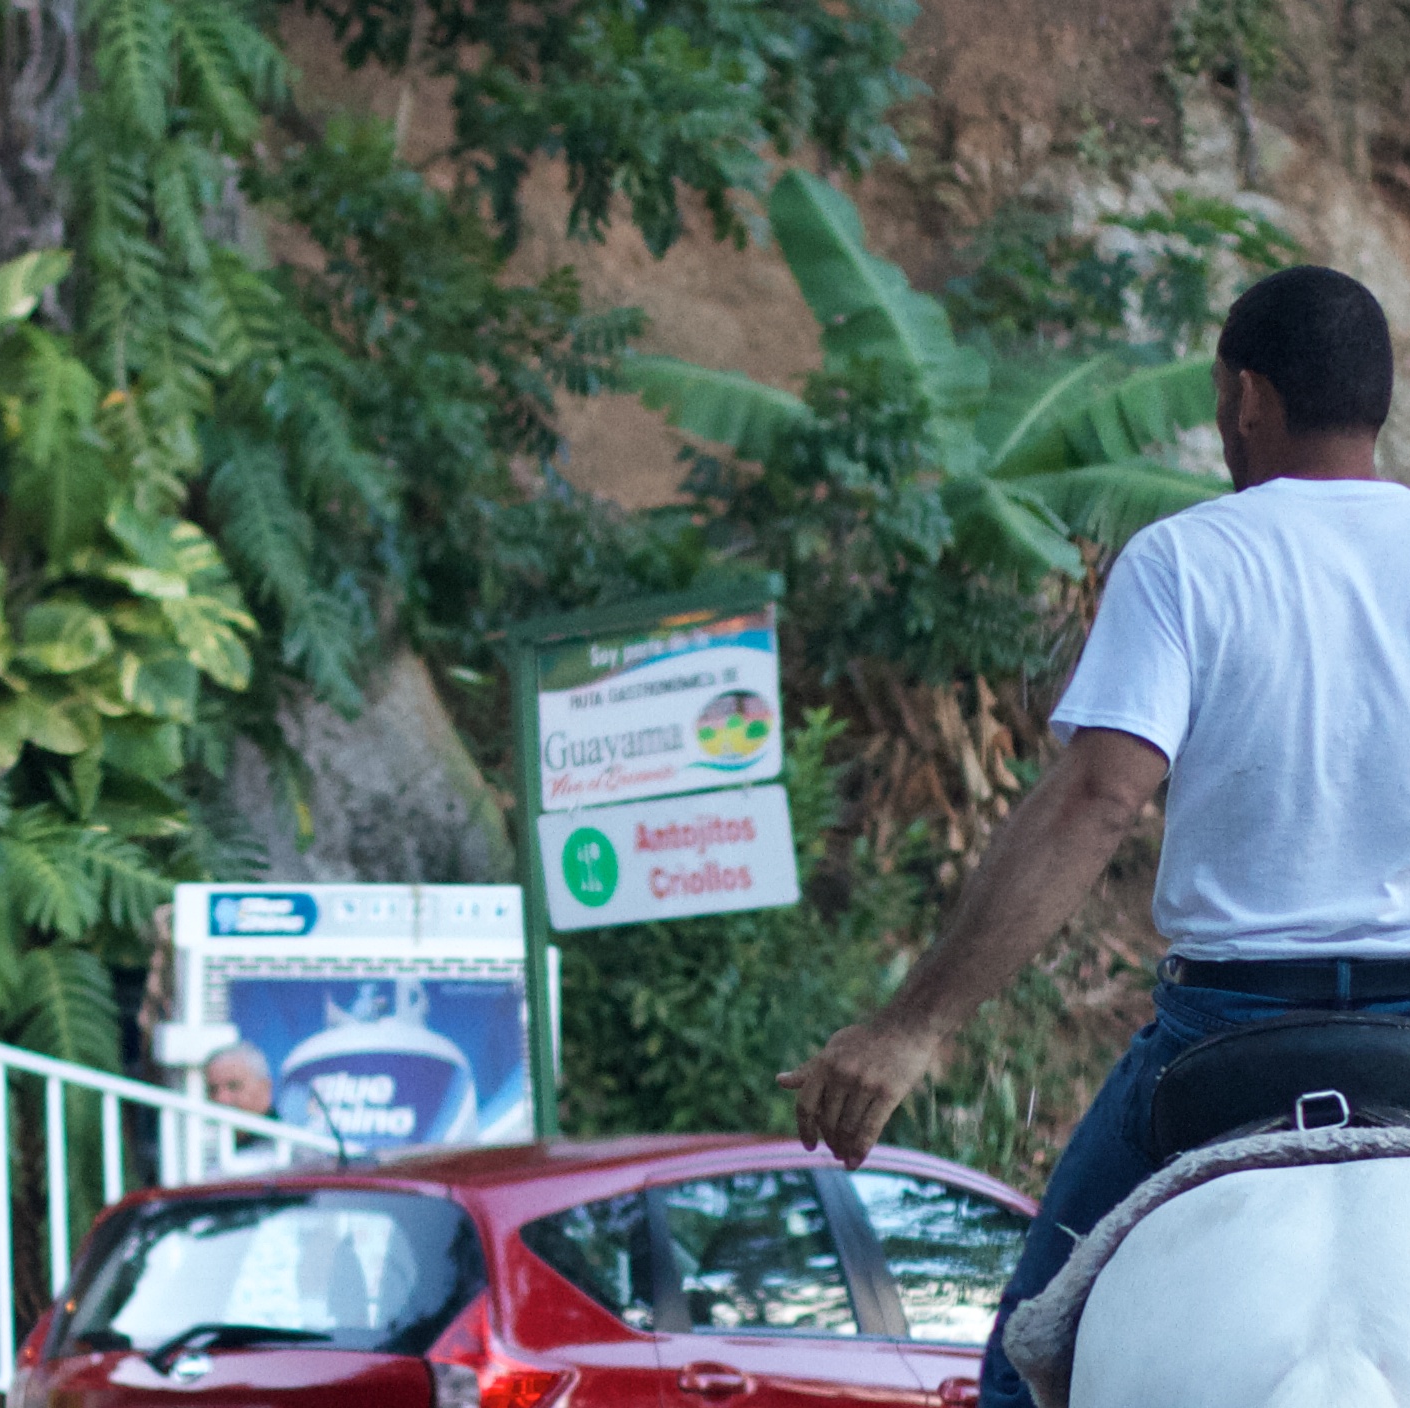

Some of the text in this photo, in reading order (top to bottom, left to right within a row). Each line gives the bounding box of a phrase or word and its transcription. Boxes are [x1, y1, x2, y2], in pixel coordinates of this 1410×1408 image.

[544, 722, 684, 774] Guayama
[634, 814, 757, 855] Antojitos
[649, 860, 754, 899] Criollos
